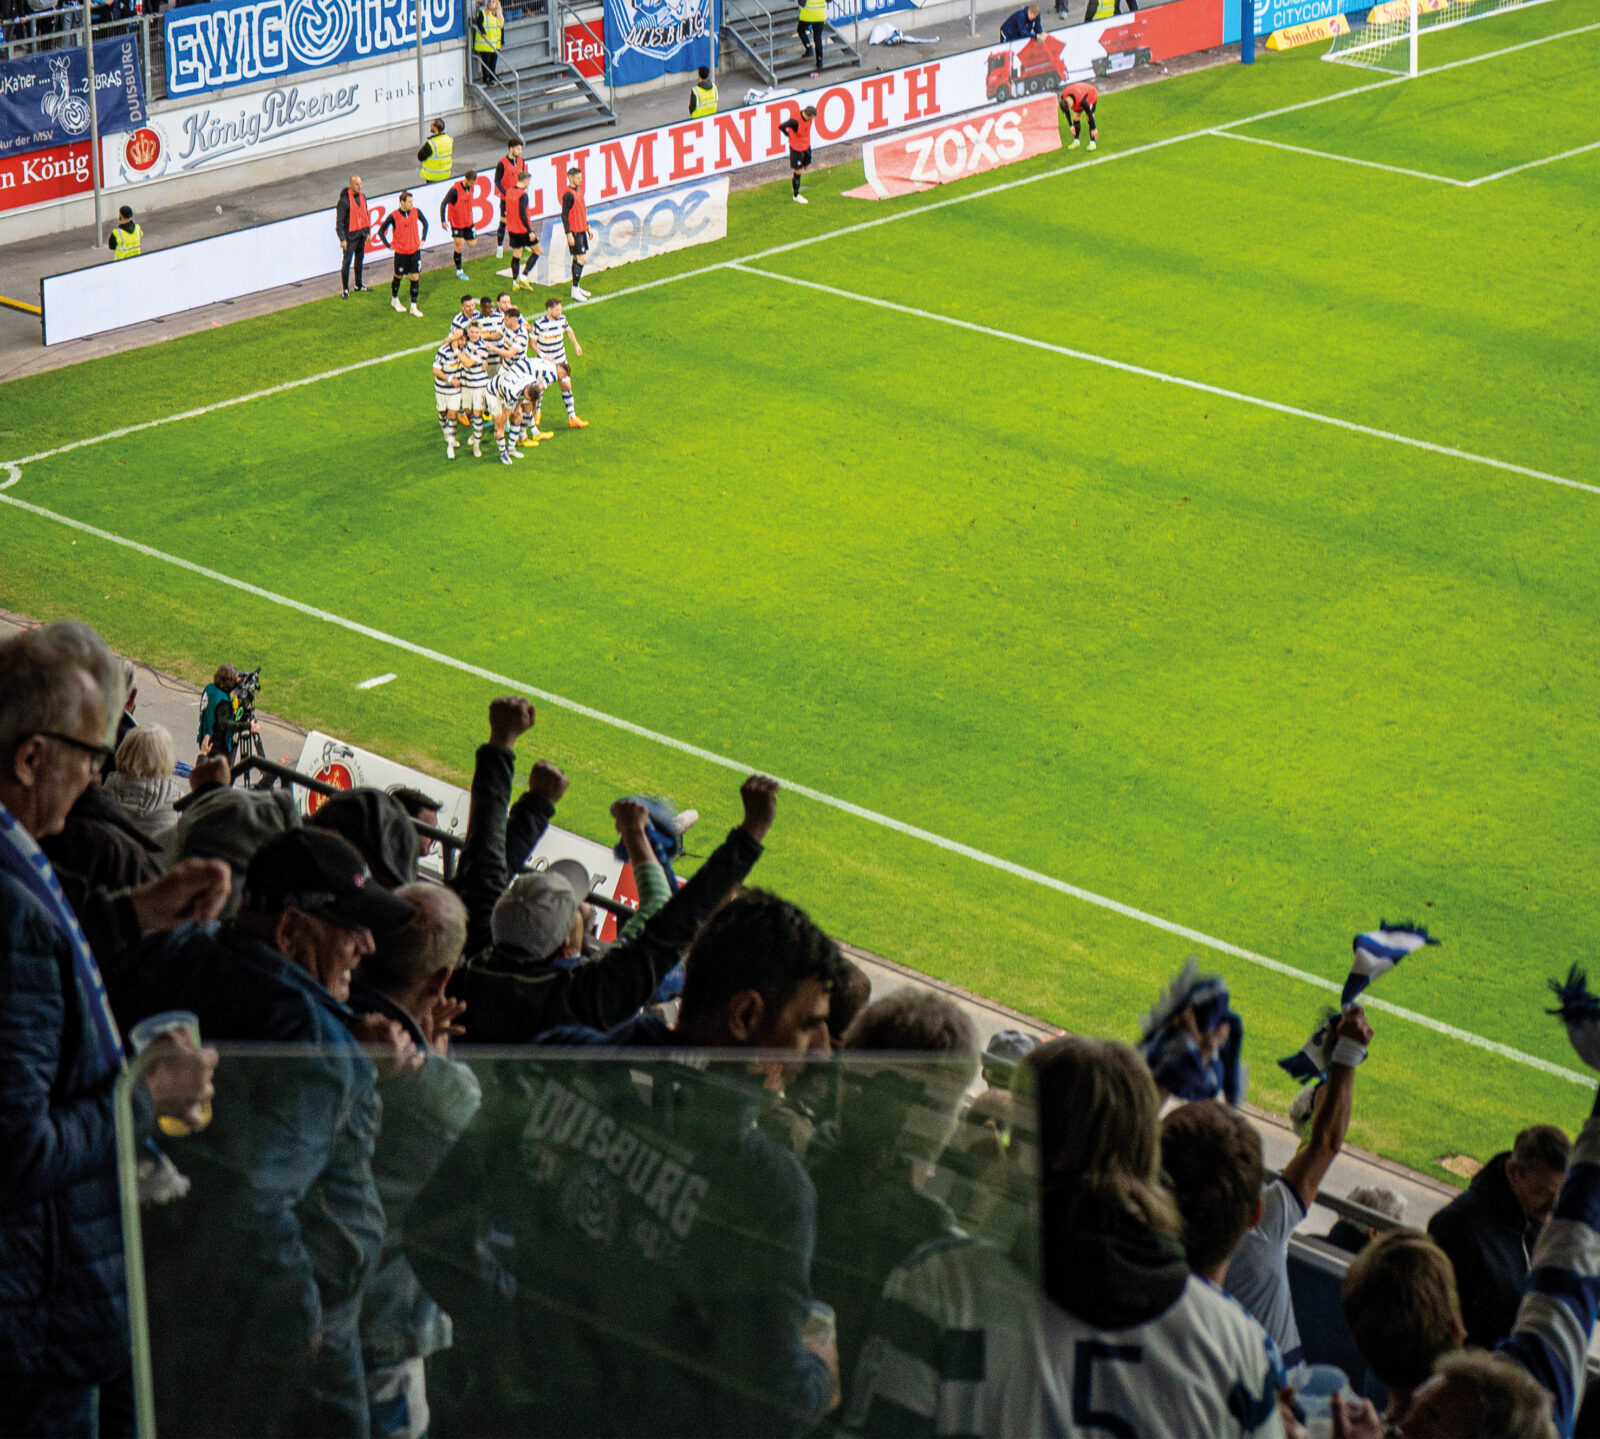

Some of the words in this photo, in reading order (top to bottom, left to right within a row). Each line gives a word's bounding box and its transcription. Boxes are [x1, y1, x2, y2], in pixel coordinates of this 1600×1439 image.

[168, 0, 288, 93] EWIG
[1273, 0, 1333, 28] CITY.COM
[1282, 24, 1325, 47] Sinalco
[121, 41, 143, 123] DUISBURG
[15, 134, 31, 147] der
[33, 129, 55, 144] MSV
[179, 108, 268, 160] König
[262, 83, 361, 134] Pilsener
[448, 62, 941, 233] BUMENROTH
[905, 110, 1026, 186] ZOXS
[21, 150, 91, 186] König
[522, 1078, 710, 1238] DUISBURG
